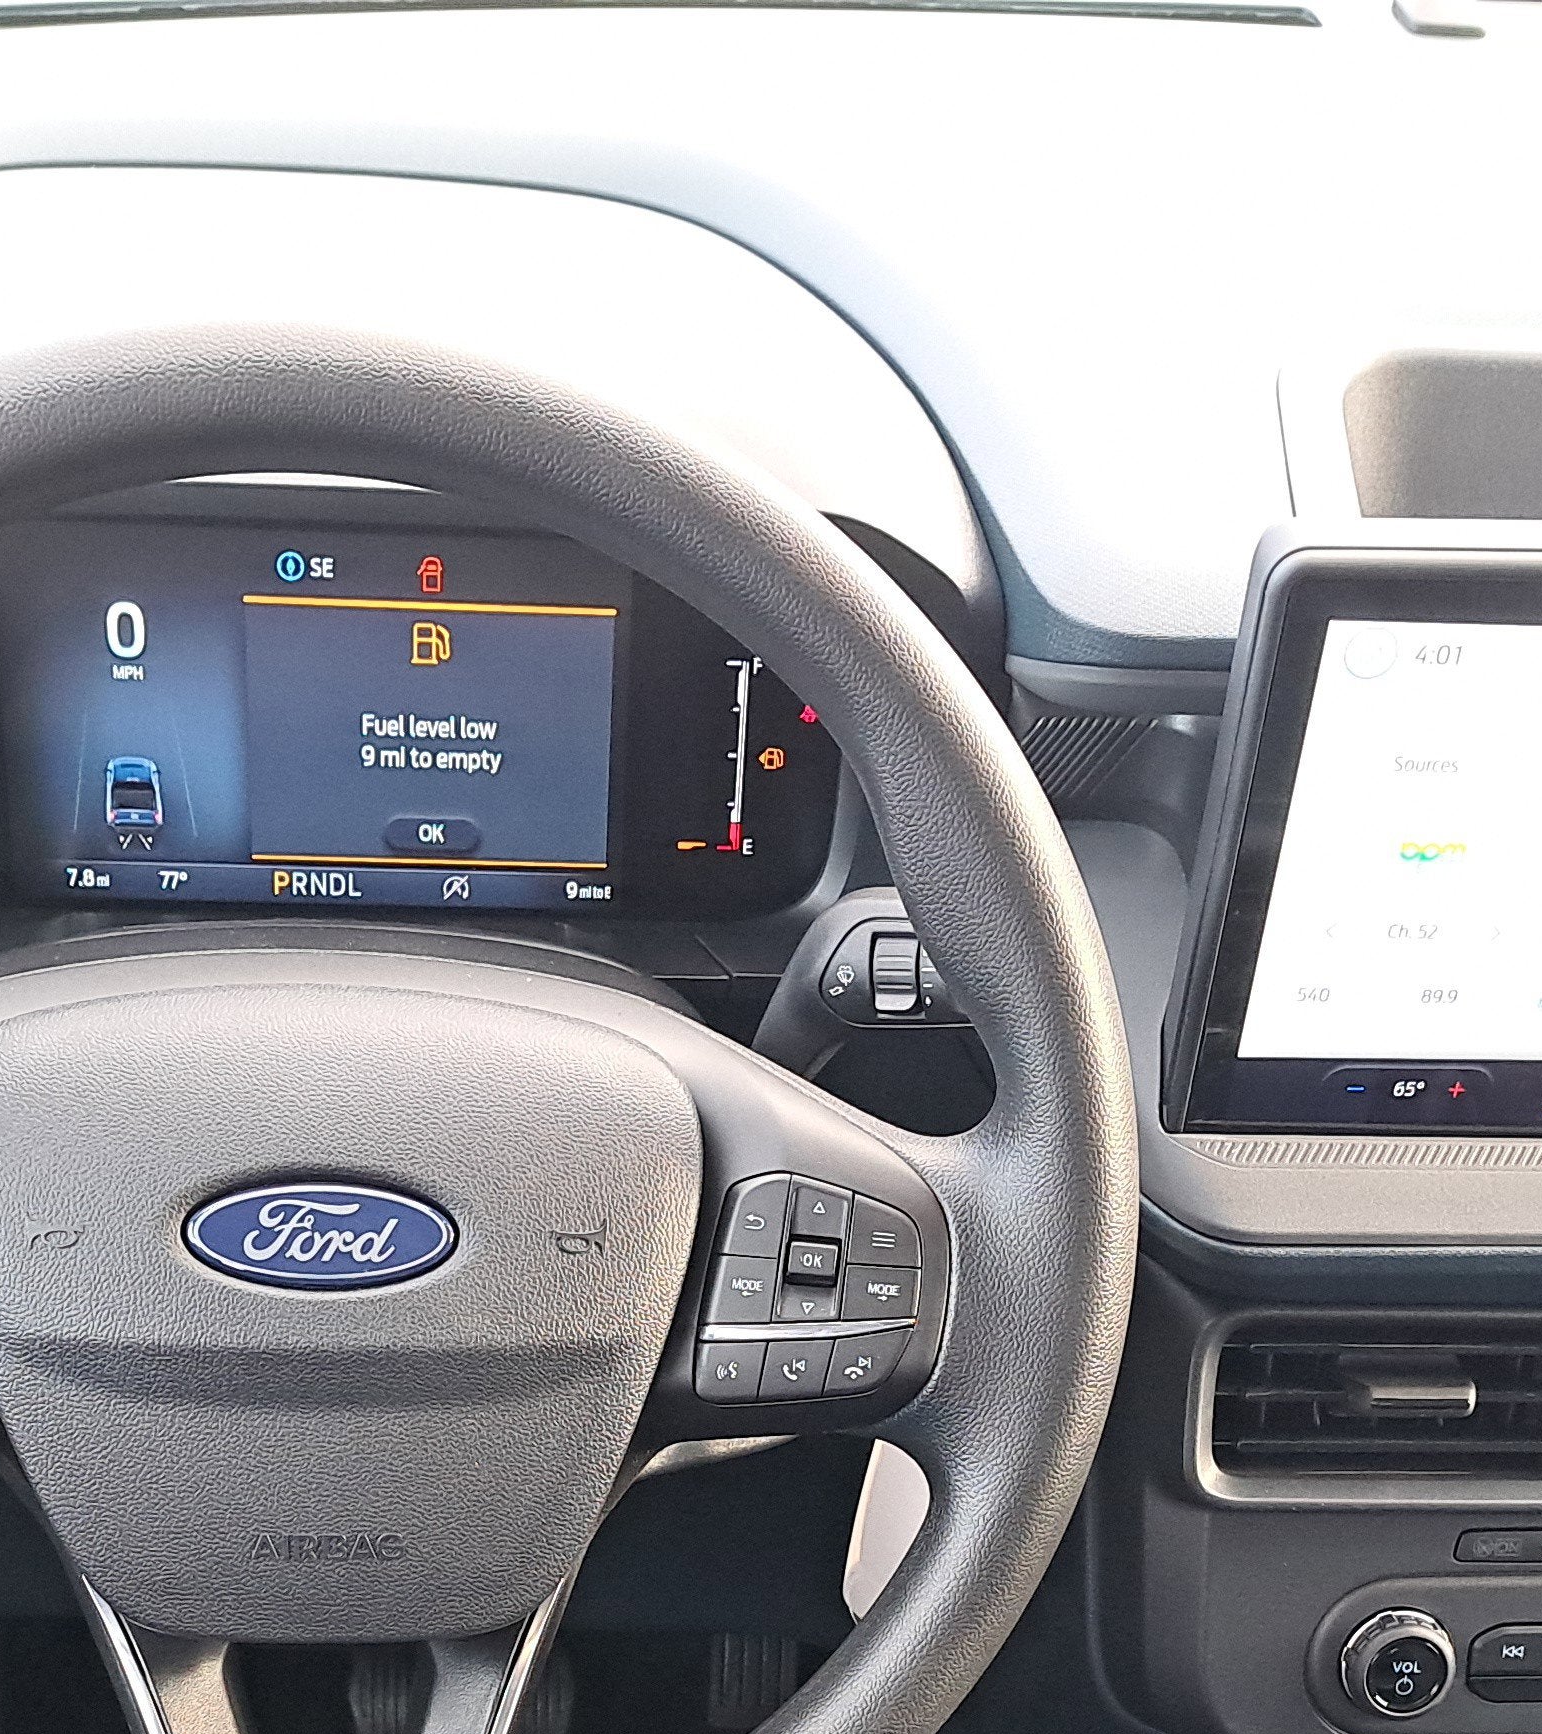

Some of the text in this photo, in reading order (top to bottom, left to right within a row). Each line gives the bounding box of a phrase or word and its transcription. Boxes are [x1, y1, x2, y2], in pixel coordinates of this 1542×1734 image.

[309, 557, 334, 579] SE
[106, 601, 147, 659] 0
[1415, 645, 1465, 667] 4:01
[112, 665, 144, 681] MPH
[361, 713, 498, 740] Fuel level low
[360, 745, 374, 767] 9
[409, 748, 433, 769] to
[435, 748, 502, 775] empty
[1393, 755, 1460, 775] Sources
[417, 823, 446, 844] OK
[742, 838, 755, 855] E
[66, 867, 95, 887] 7.8
[566, 881, 579, 899] 9
[1386, 923, 1439, 941] Ch. 52
[1296, 986, 1331, 1004] 540
[1420, 988, 1459, 1005] 89.9
[241, 1198, 396, 1264] Ford
[801, 1253, 823, 1269] OK
[731, 1277, 764, 1292] MODE
[867, 1281, 902, 1296] MODE
[251, 1531, 407, 1560] AIRBAG
[1392, 1661, 1422, 1674] VOL
